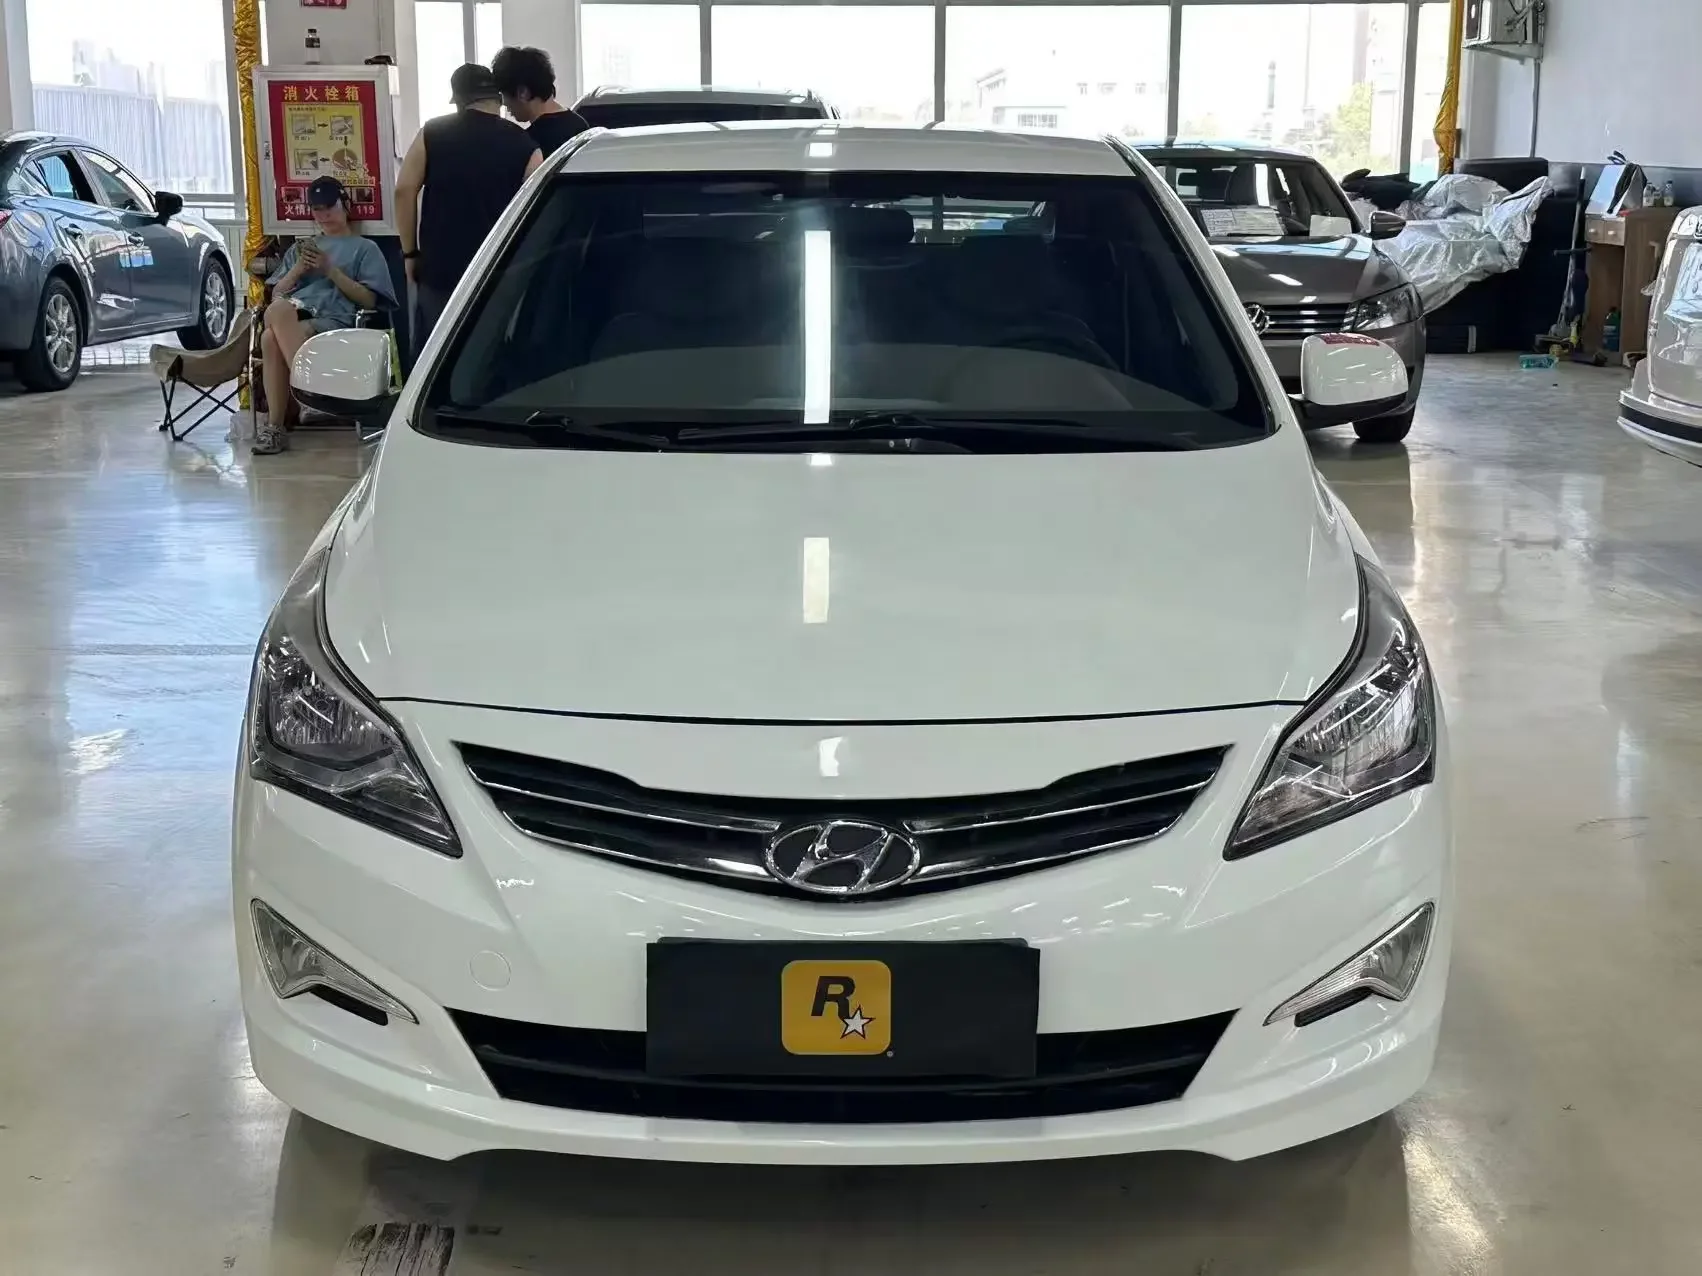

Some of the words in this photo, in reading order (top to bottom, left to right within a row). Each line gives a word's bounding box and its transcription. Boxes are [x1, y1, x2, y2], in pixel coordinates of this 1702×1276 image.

[283, 85, 360, 101] 消火栓箱
[357, 205, 375, 215] 119
[811, 976, 856, 1019] R
